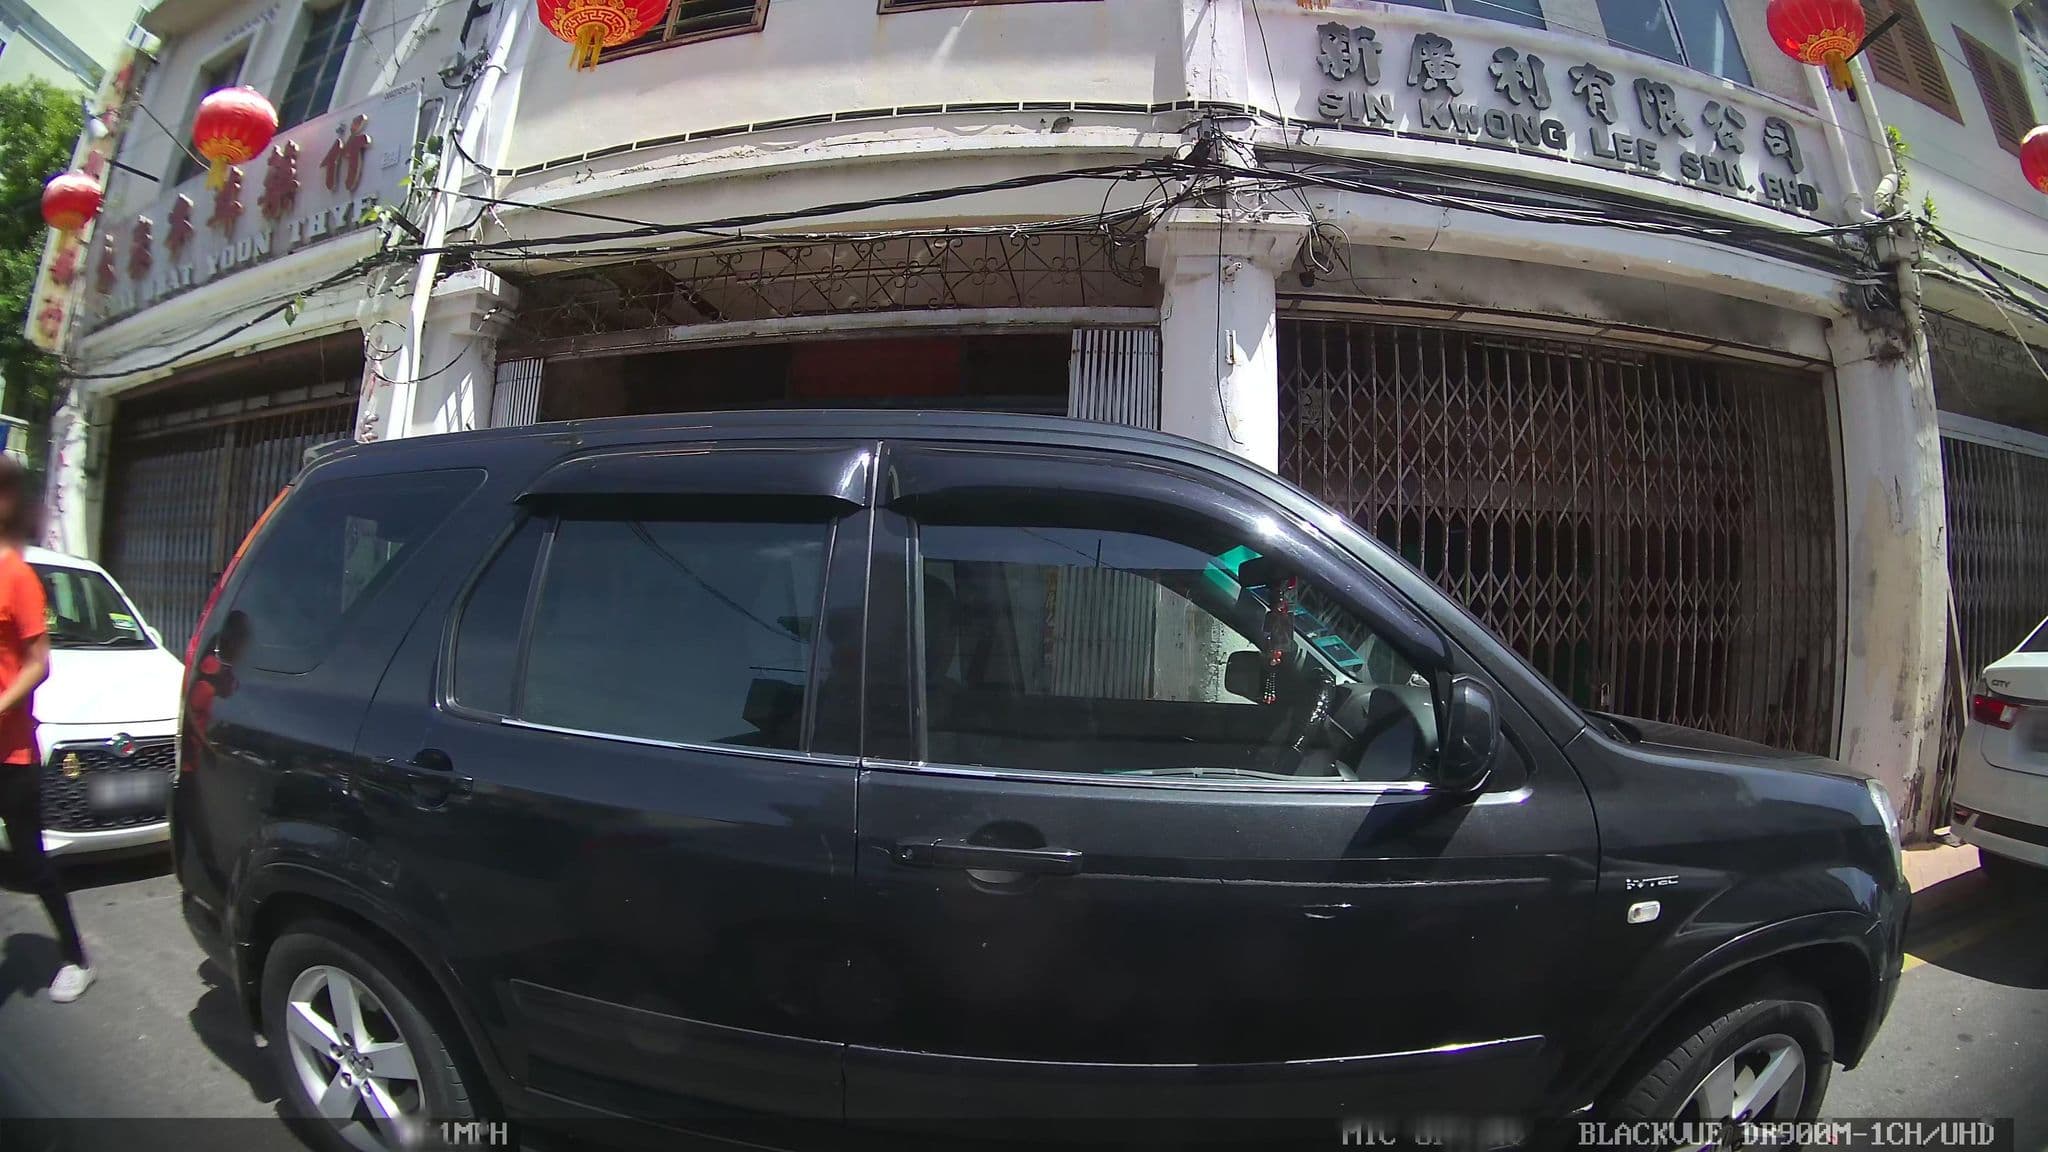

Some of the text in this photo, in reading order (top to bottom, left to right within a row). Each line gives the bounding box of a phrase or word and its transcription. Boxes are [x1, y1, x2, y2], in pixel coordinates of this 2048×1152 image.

[1316, 21, 1805, 175] 新廣利有限公司
[1317, 88, 1818, 212] SIN KWONG LEE SDN. BHD
